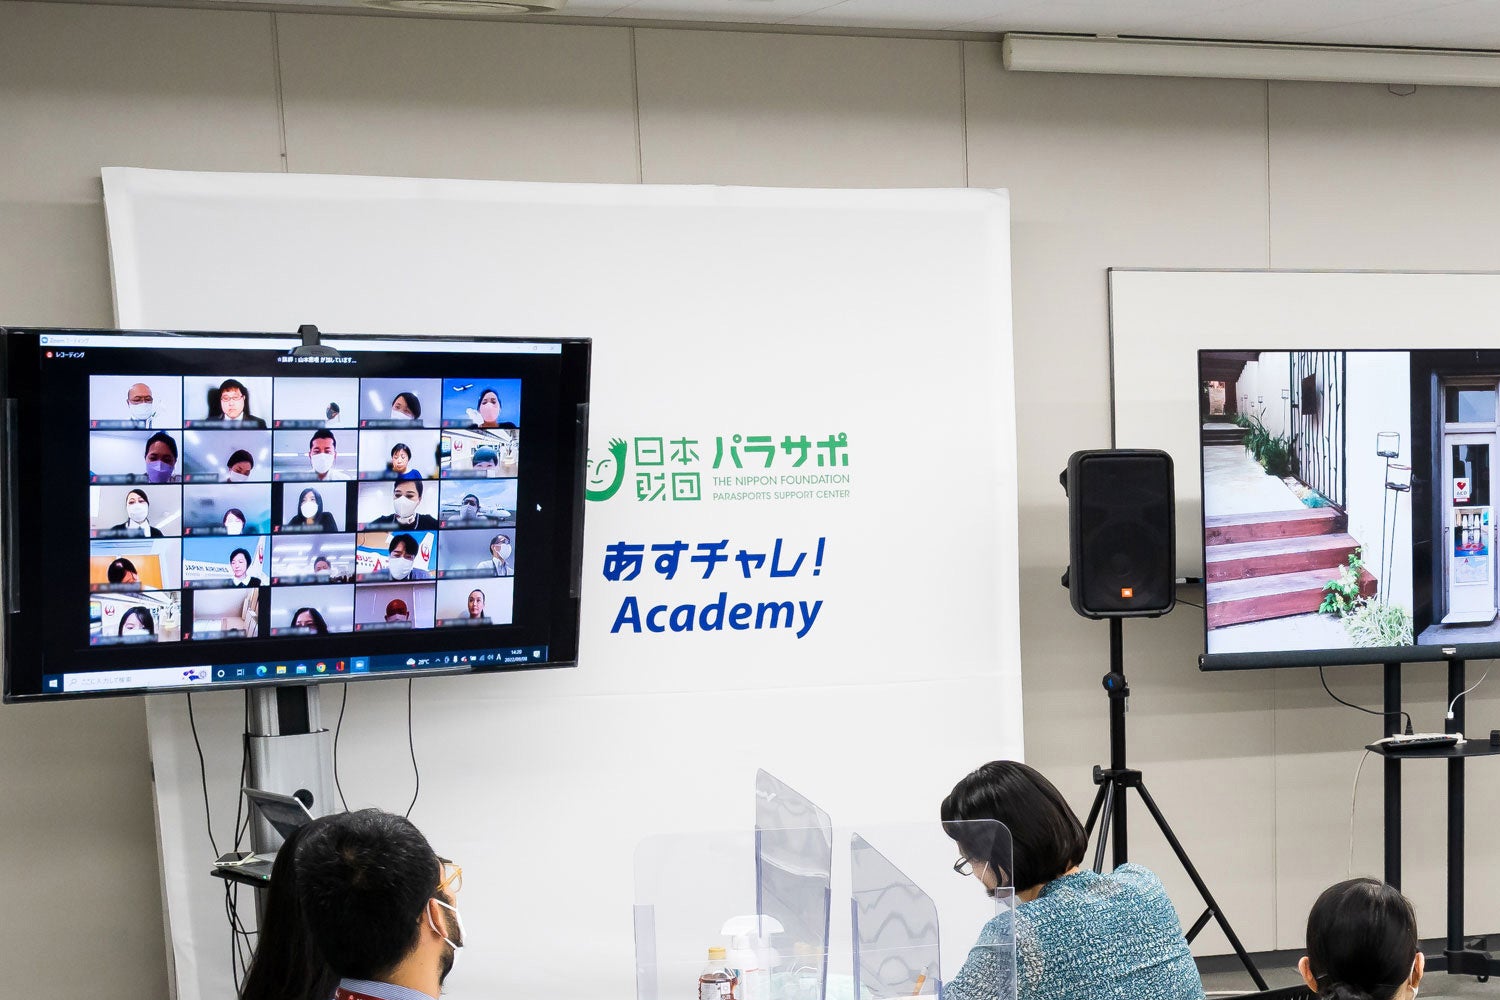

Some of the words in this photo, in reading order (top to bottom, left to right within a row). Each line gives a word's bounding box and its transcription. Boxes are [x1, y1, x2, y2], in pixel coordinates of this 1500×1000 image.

[634, 437, 698, 466] 日本
[713, 432, 848, 469] パラサポ
[636, 472, 701, 501] 財団
[712, 477, 732, 486] THE
[735, 476, 777, 485] NIPPON
[780, 474, 850, 485] FOUNDATION
[713, 492, 771, 500] PARASPORTS
[774, 490, 813, 500] SUPPORT
[815, 490, 850, 498] CENTER
[611, 592, 823, 639] Academy
